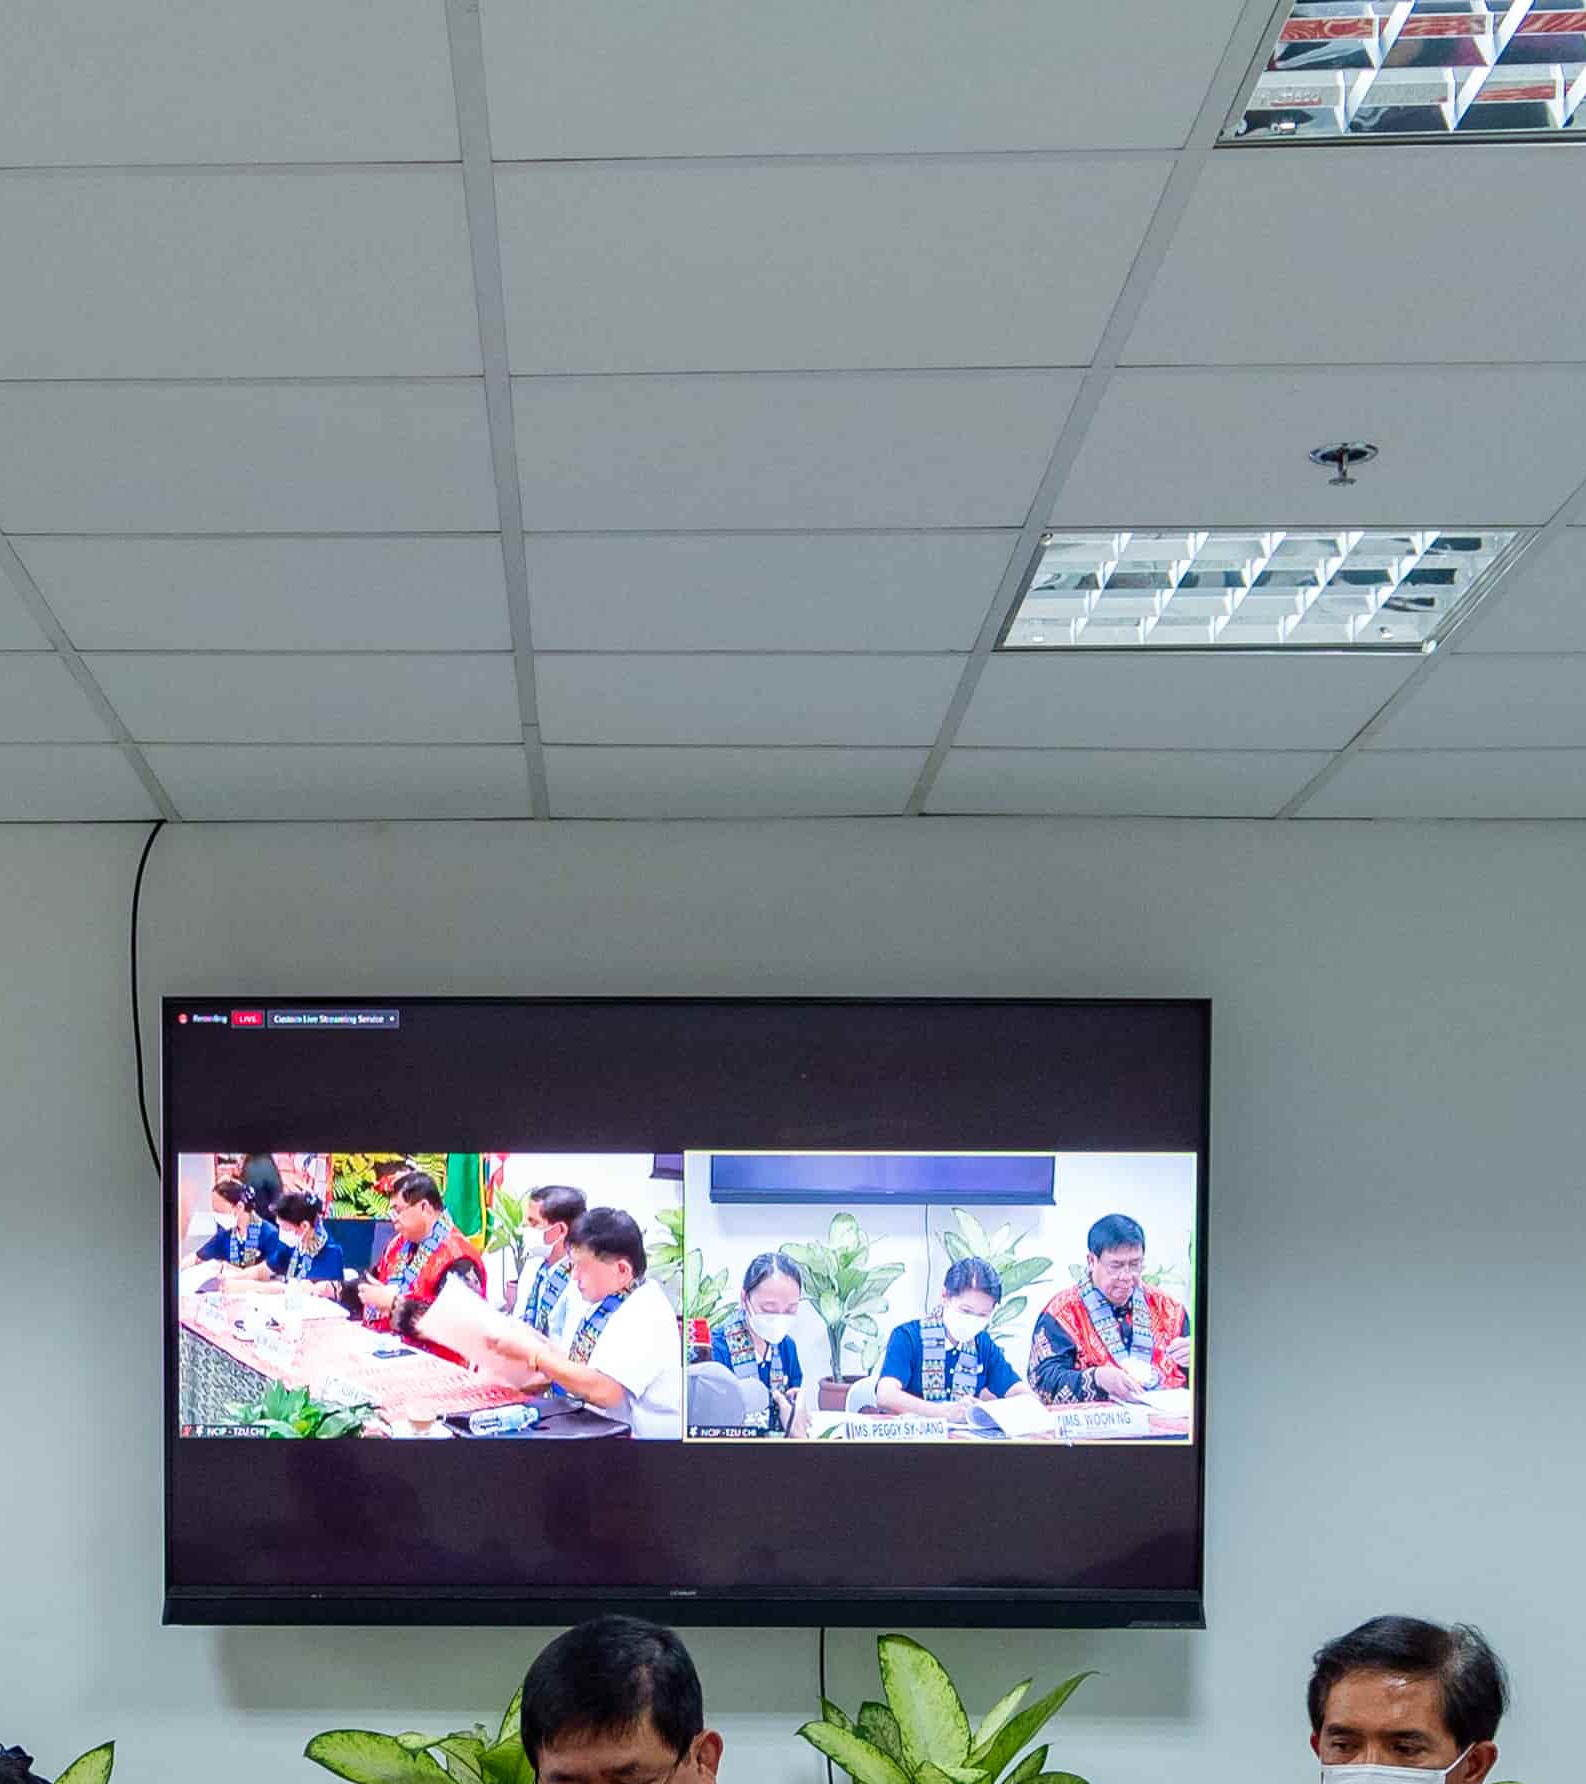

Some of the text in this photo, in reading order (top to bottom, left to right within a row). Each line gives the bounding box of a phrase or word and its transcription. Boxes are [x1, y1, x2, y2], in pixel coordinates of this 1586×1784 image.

[239, 1015, 257, 1024] LIVE
[1084, 1412, 1115, 1426] WOON
[872, 1423, 902, 1437] PEGGY
